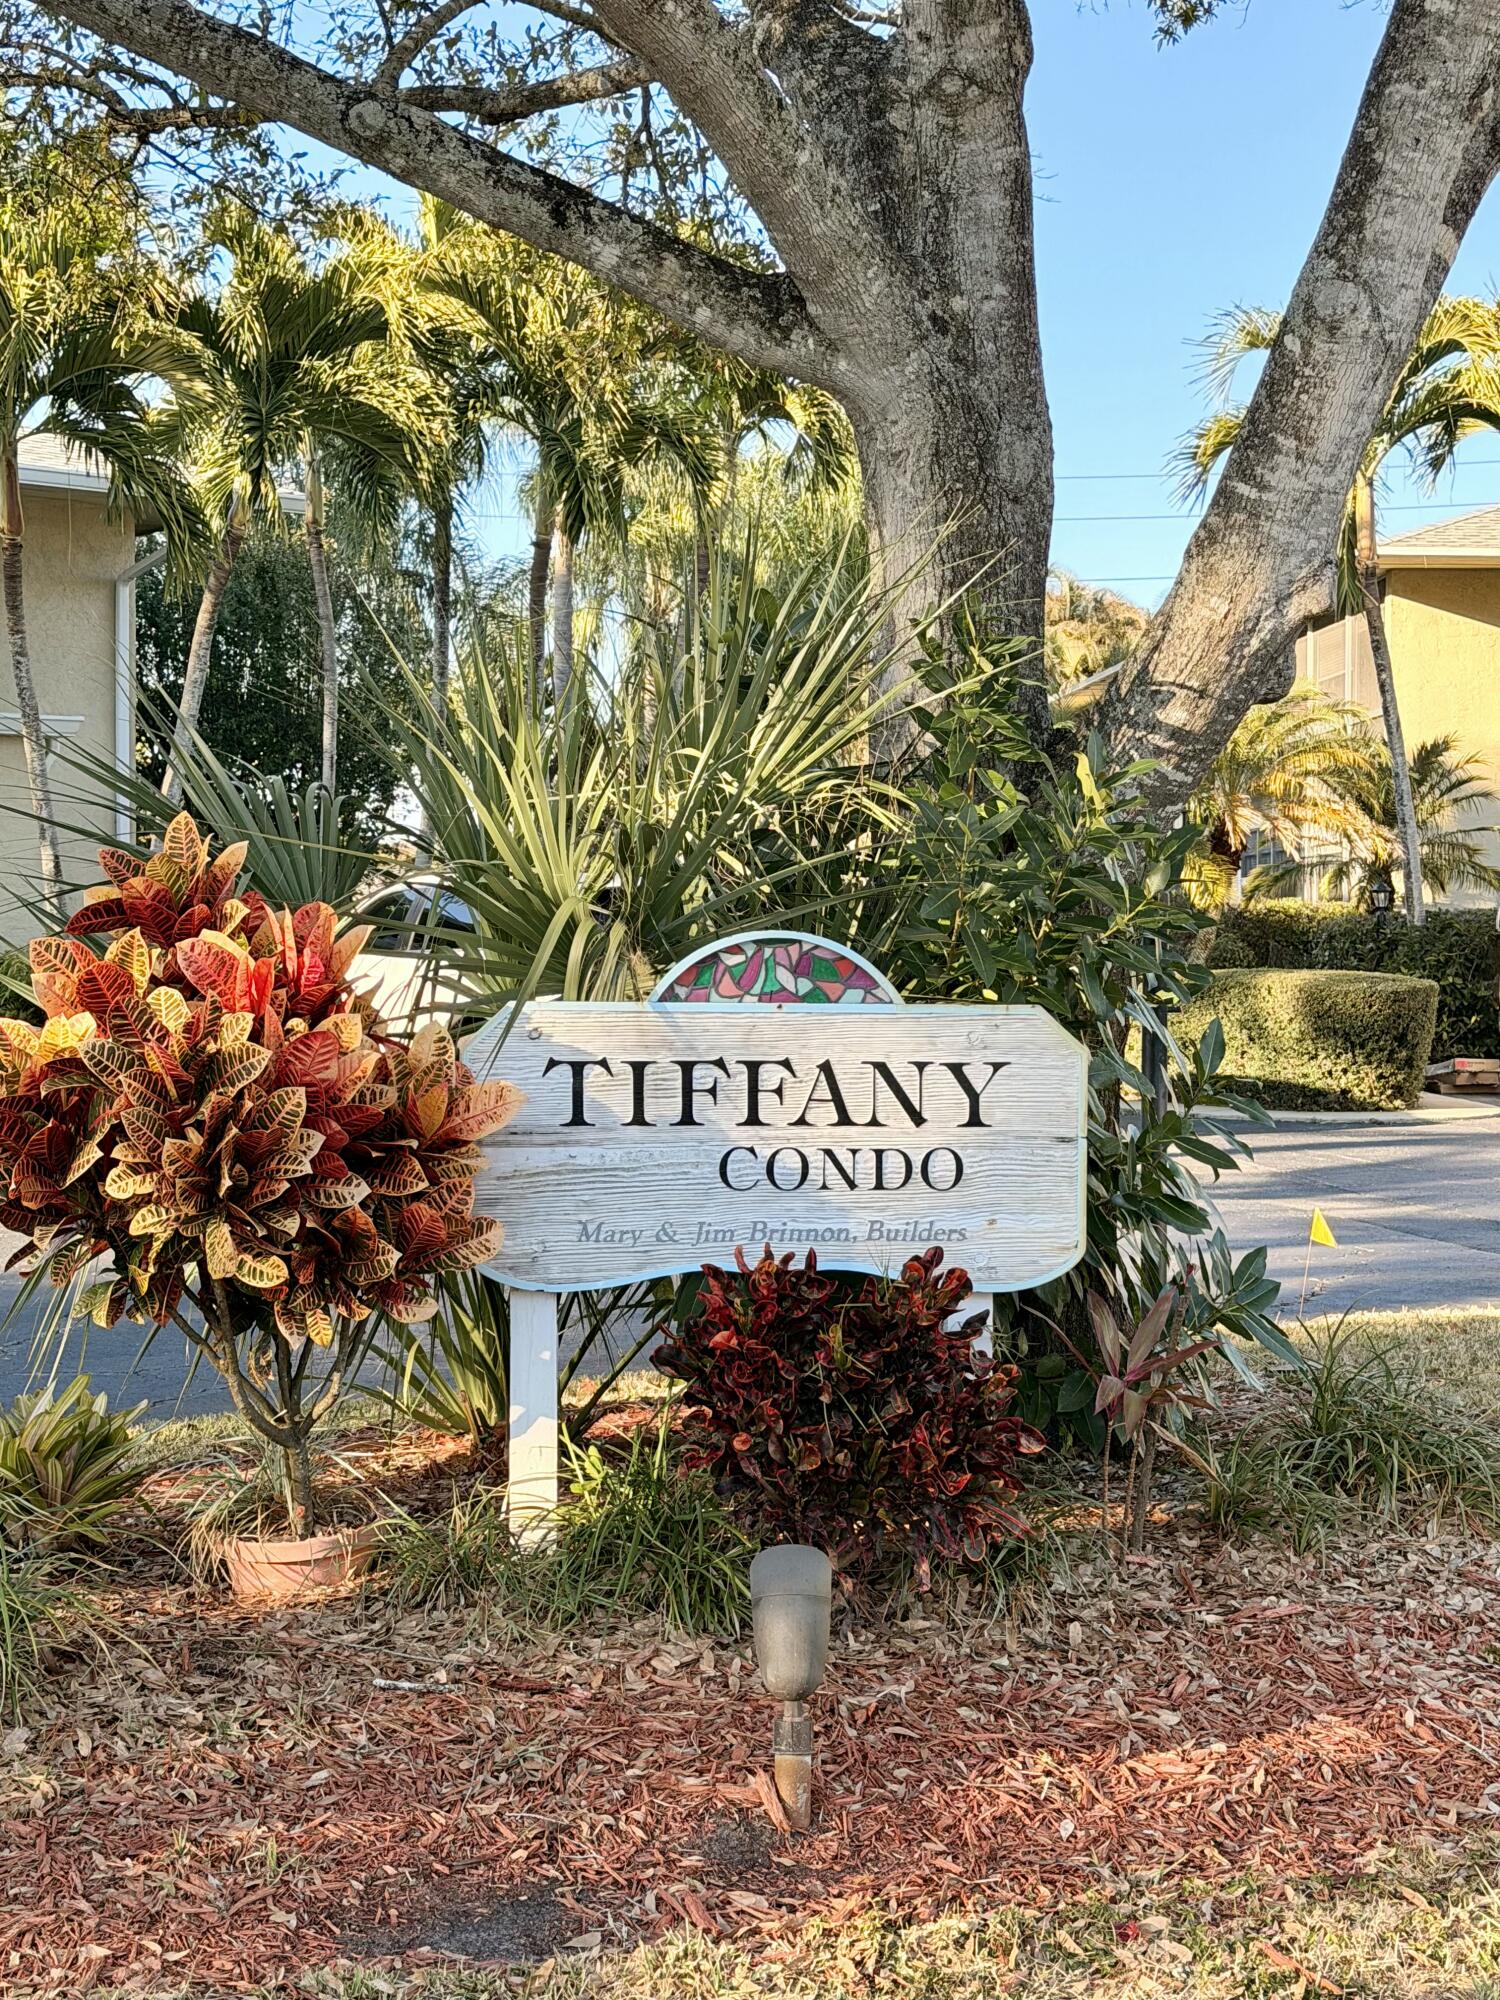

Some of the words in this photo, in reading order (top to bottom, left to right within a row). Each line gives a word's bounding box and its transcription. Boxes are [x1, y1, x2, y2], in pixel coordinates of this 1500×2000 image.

[542, 1056, 1011, 1128] TIFFANY
[718, 1146, 964, 1192] CONDO
[576, 1220, 643, 1248] Mary
[655, 1221, 680, 1243] &
[691, 1220, 736, 1247] Jim
[749, 1219, 858, 1244] Brinnon,
[865, 1219, 968, 1242] Builders
